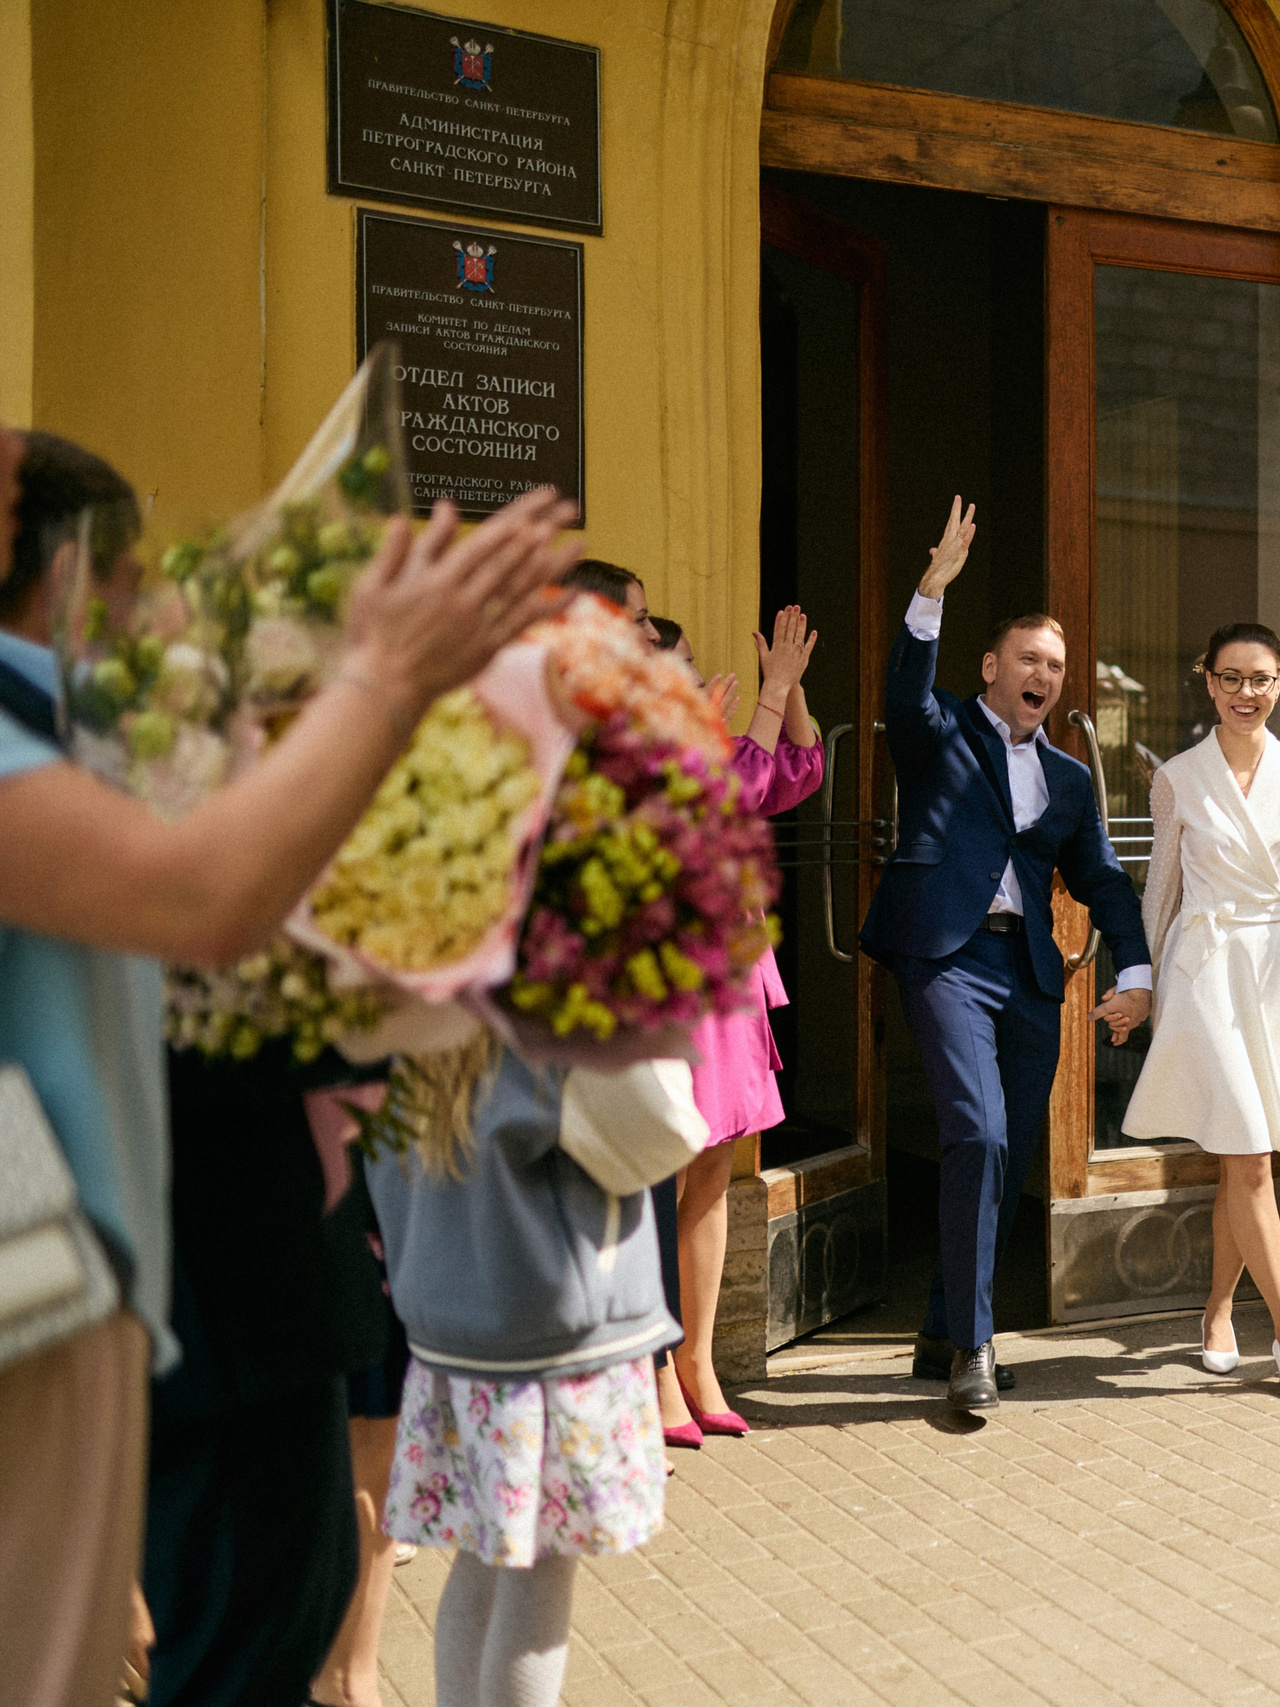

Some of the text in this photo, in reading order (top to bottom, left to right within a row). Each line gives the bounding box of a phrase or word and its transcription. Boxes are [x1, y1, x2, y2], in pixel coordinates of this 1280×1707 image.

[368, 78, 459, 105] ПРАВИТЕЛЬСТВО
[399, 113, 543, 151] АДМИНИСТРАЦИЯ
[362, 129, 577, 179] ПЕТРОГРАДСКОГО РАЙОНА
[372, 285, 464, 305] ПРАВИТЕЛЬСТВО
[386, 322, 560, 351] ЗАПИСИ АКТОВ ГРАЖДАНСКОГО
[418, 313, 531, 336] КОМИТЕТ ПО ДЕЛАМ
[443, 341, 508, 356] СОСТОЯНИЯ
[393, 365, 556, 398] ОТДЕЛ ЗАПИСИ
[442, 393, 510, 415] АКТОВ
[396, 410, 560, 441] РАЖДАНСКОГО
[412, 435, 537, 461] СОСТОЯНИЯ
[404, 472, 557, 494] ТРОГРАДСКОГО РАЙОНА
